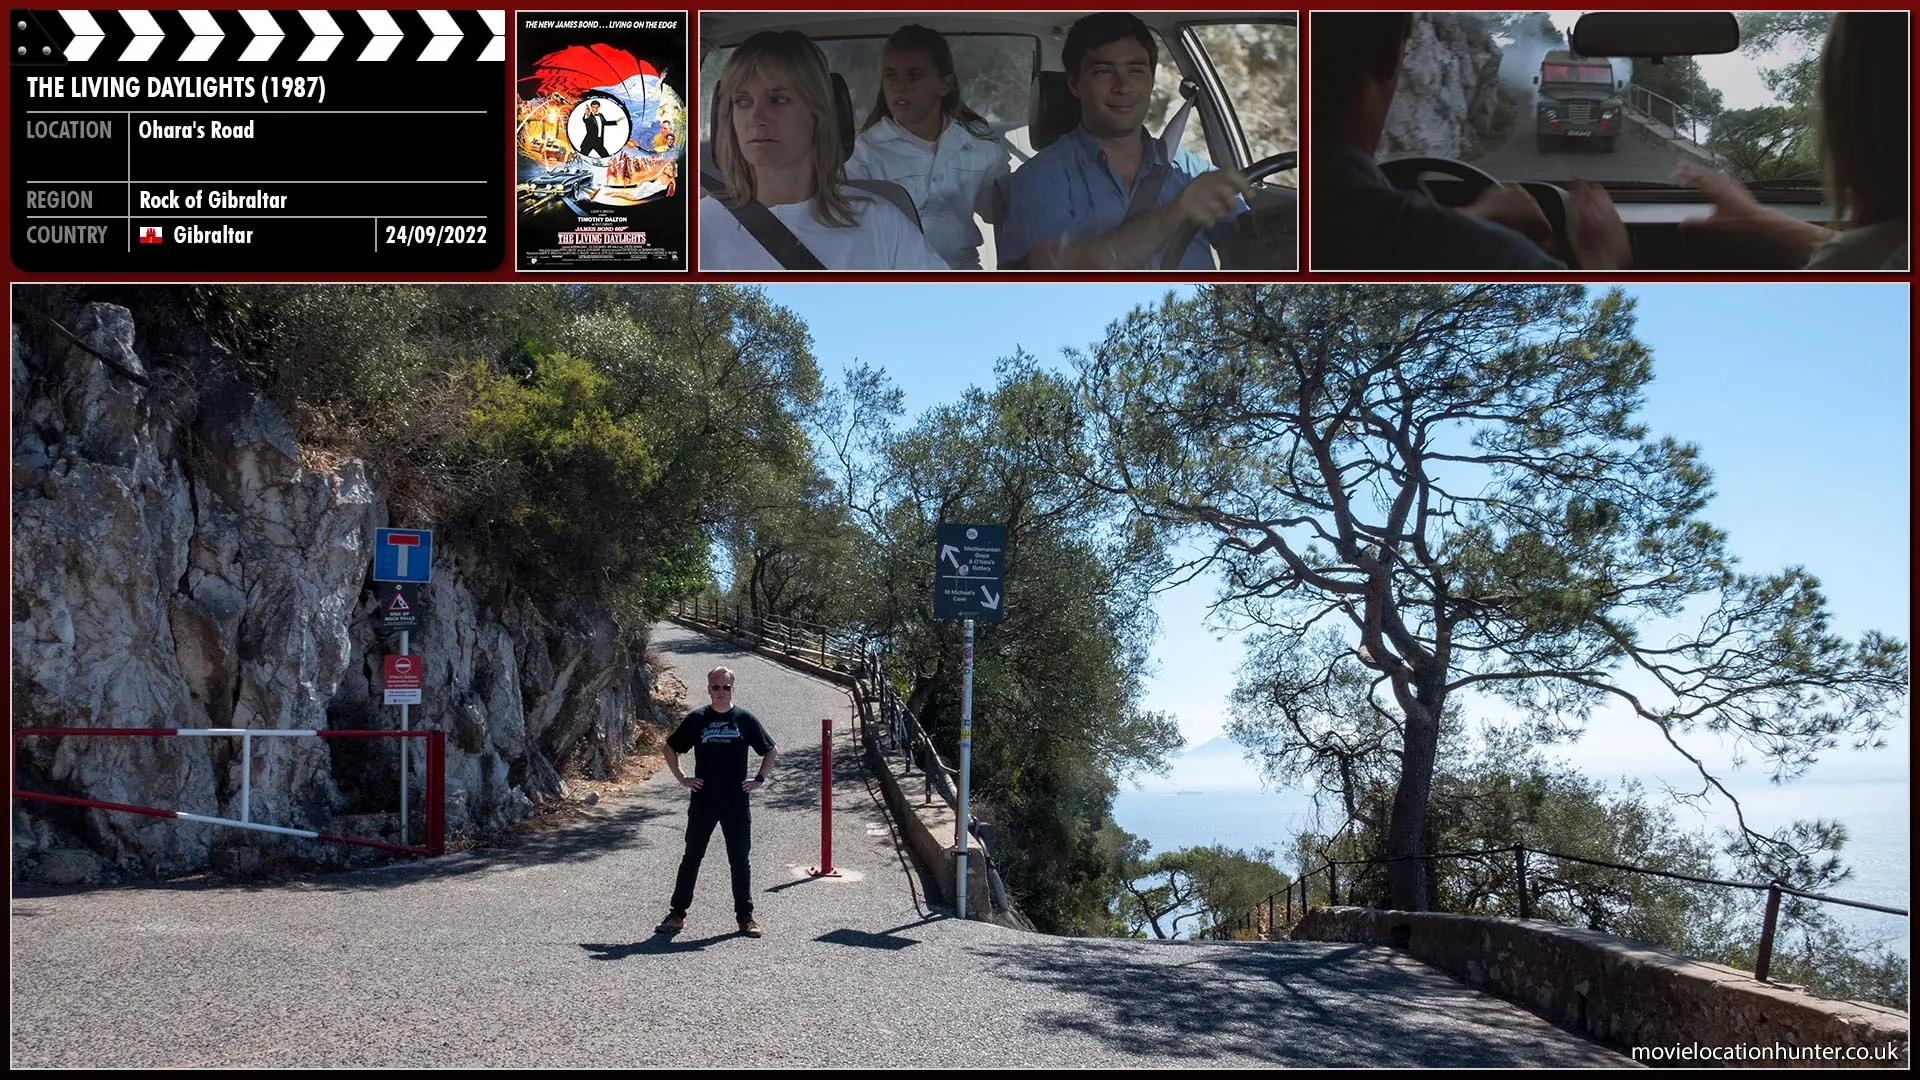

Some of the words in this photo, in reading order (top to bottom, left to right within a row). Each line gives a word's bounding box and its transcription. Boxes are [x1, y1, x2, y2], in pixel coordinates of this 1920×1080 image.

[525, 21, 538, 29] THE
[538, 21, 555, 29] NEW
[555, 21, 578, 29] JAMES
[578, 21, 599, 29] BOND
[609, 21, 632, 29] LIVING
[633, 21, 645, 29] ON
[645, 21, 658, 29] THE
[658, 21, 678, 29] EDGE
[558, 232, 574, 244] THE
[575, 232, 602, 244] LIVING
[604, 232, 646, 244] DAYLIGHTS
